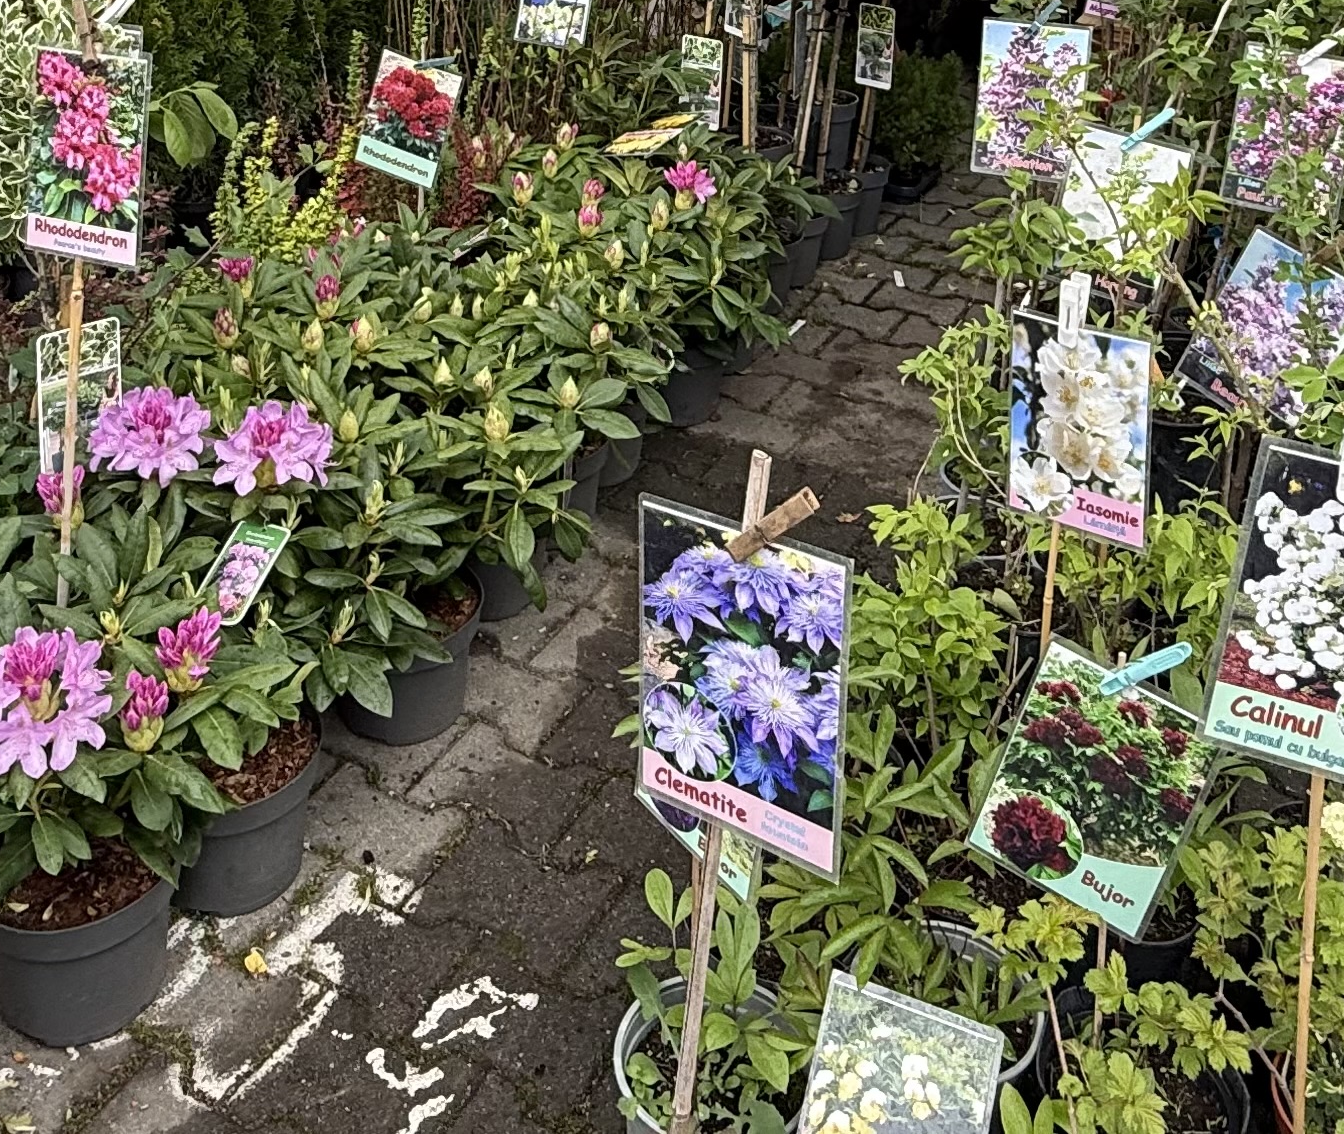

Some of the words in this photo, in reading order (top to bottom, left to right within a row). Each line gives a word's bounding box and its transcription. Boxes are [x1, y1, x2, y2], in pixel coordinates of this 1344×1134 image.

[363, 145, 429, 178] Rhododendron
[35, 217, 128, 249] Rhododendron
[1076, 496, 1139, 528] Iasomie
[1230, 695, 1324, 739] Calinul
[1213, 719, 1241, 738] Sau
[1244, 729, 1284, 750] pomul
[1286, 742, 1304, 756] cu
[654, 767, 748, 824] Clematite
[1080, 869, 1136, 909] Bujor
